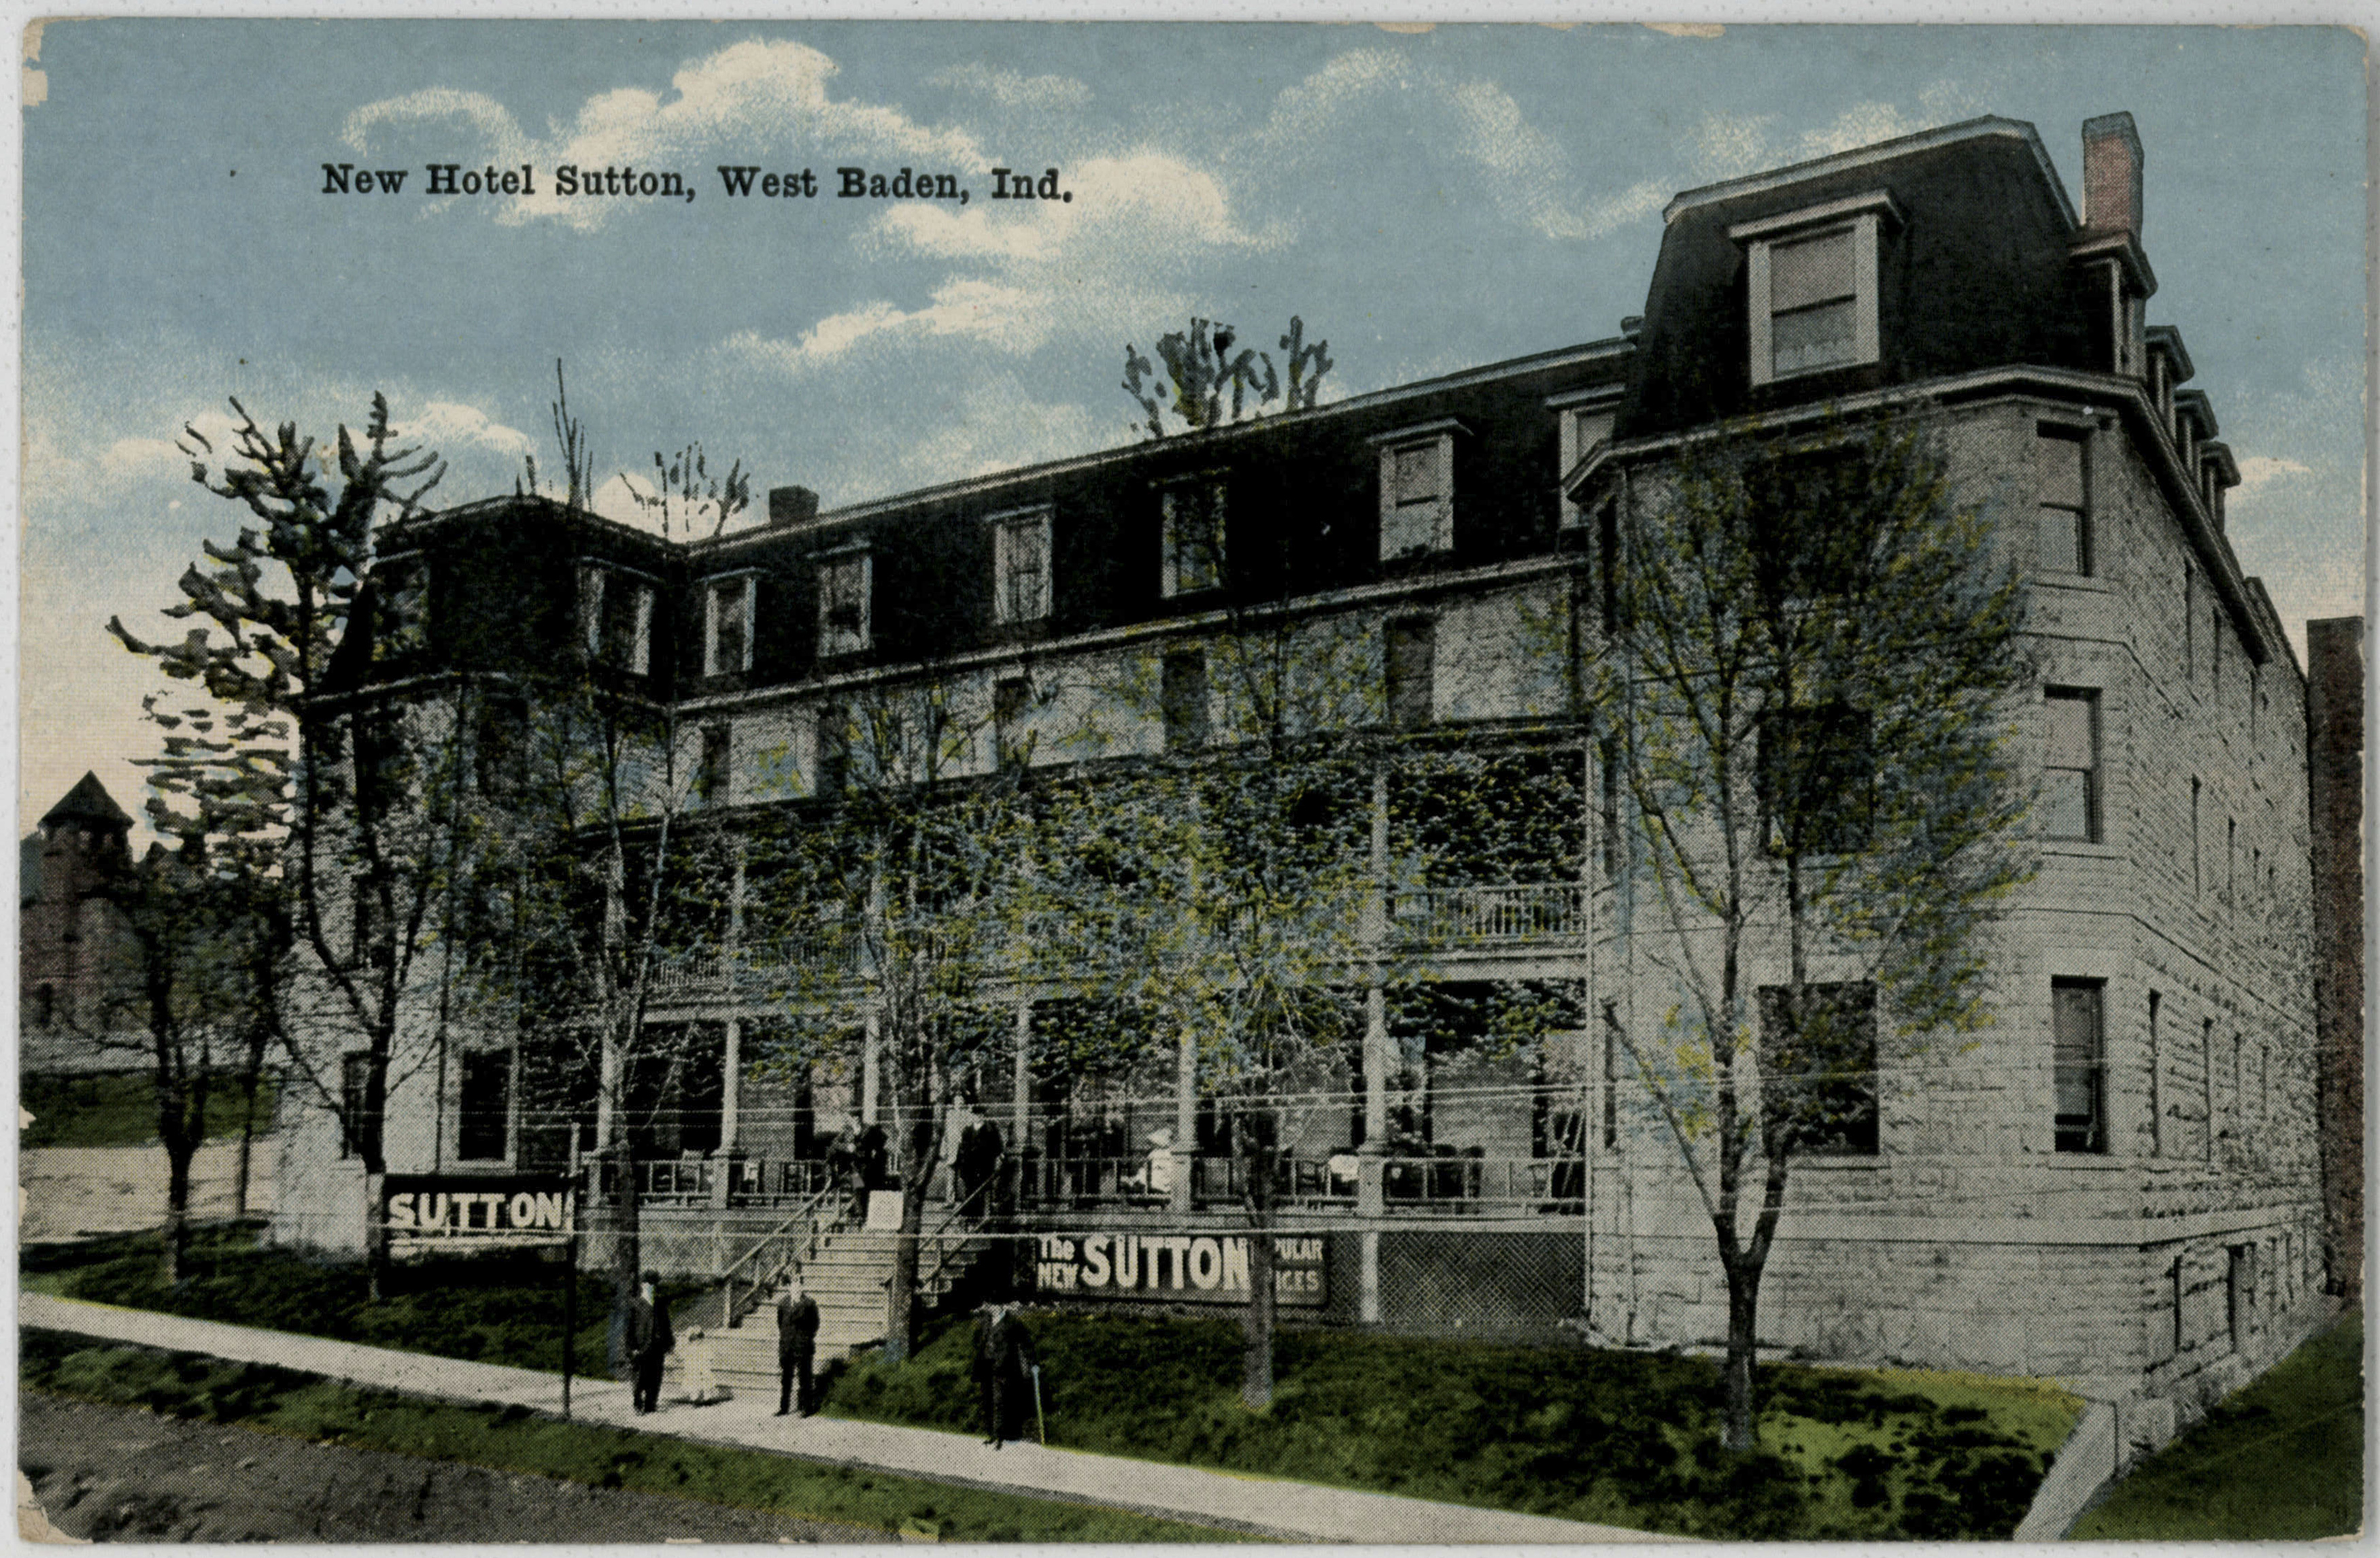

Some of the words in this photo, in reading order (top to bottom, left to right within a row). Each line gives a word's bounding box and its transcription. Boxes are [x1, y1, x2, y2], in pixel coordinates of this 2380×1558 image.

[388, 1191, 563, 1228] SUTTON
[1038, 1234, 1076, 1261] The
[1274, 1238, 1323, 1260] ULAR
[1037, 1262, 1080, 1289] NEW
[1081, 1234, 1251, 1290] SUTTON
[1275, 1269, 1321, 1291] ICES
